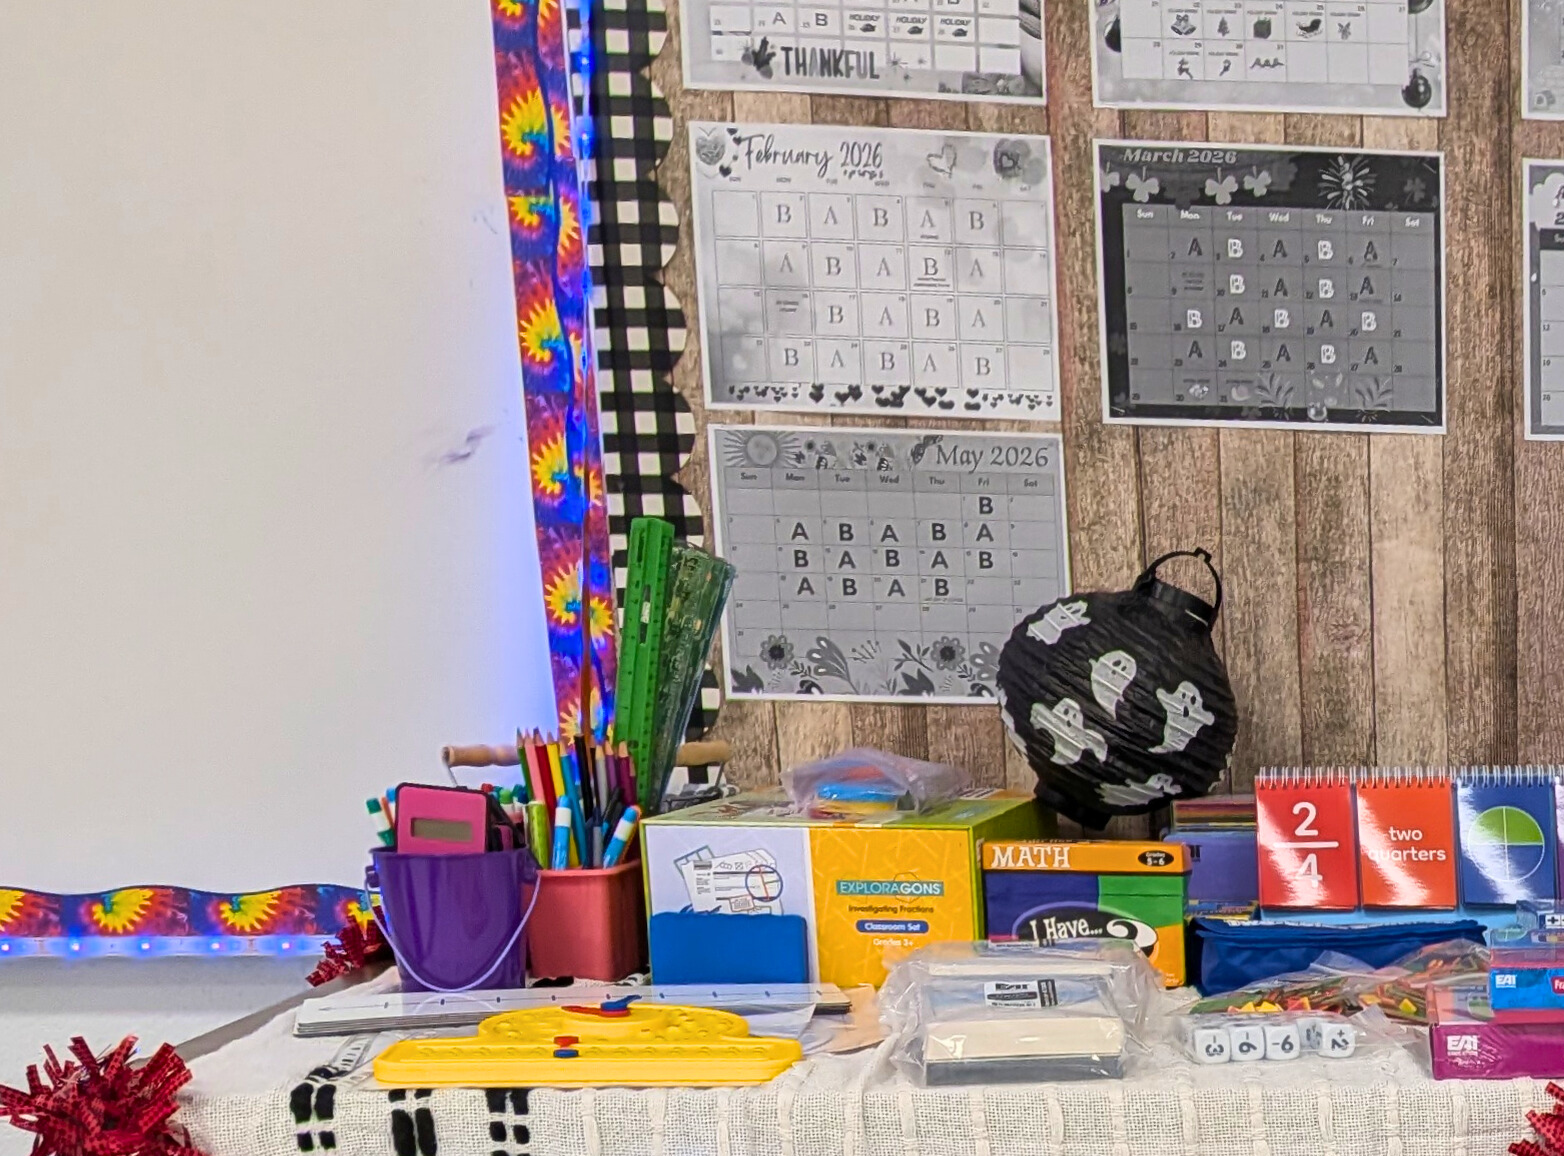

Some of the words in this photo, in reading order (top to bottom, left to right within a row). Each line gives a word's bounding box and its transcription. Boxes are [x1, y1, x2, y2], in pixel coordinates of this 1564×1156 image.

[772, 12, 787, 25] A
[816, 13, 828, 26] B
[849, 14, 881, 23] HOLIDAY
[896, 16, 927, 25] HOLIDAY
[940, 18, 971, 27] HOLIDAY
[780, 46, 880, 79] THANKFUL
[740, 133, 834, 178] February
[839, 140, 883, 169] 2026
[1124, 148, 1183, 163] March
[1187, 149, 1237, 164] 2026
[777, 204, 792, 224] B
[824, 206, 838, 225] A
[873, 208, 888, 227] B
[920, 209, 936, 229] A
[970, 211, 985, 230] B
[1188, 238, 1203, 257] A
[1228, 238, 1243, 259] B
[1273, 239, 1288, 259] A
[1318, 240, 1333, 260] B
[1363, 240, 1378, 261] A
[936, 444, 984, 474] May
[991, 447, 1049, 467] 2026
[879, 474, 899, 484] Wed
[929, 476, 945, 485] Thu
[978, 477, 990, 486] Fri
[979, 496, 993, 514] B
[791, 522, 809, 540] A
[839, 522, 854, 541] B
[881, 524, 899, 542] A
[932, 522, 946, 541] B
[976, 523, 994, 542] A
[794, 549, 809, 568] B
[838, 550, 856, 569] A
[885, 549, 900, 567] B
[931, 550, 949, 569] A
[979, 550, 993, 569] B
[797, 577, 815, 596] A
[842, 577, 857, 596] B
[887, 579, 905, 598] A
[935, 578, 950, 596] B
[1292, 801, 1319, 837] 2
[1388, 825, 1423, 843] two
[991, 846, 1071, 868] MATH
[1367, 845, 1447, 862] quarters
[1298, 852, 1324, 888] 4
[840, 881, 942, 895] EXPLORAGONS
[848, 904, 898, 914] Investigating
[900, 905, 934, 913] Fractions
[864, 922, 906, 931] Classroom
[907, 923, 921, 931] Set
[873, 938, 902, 946] Grades
[1495, 974, 1517, 987] EAI
[1447, 1035, 1478, 1050] EAI
